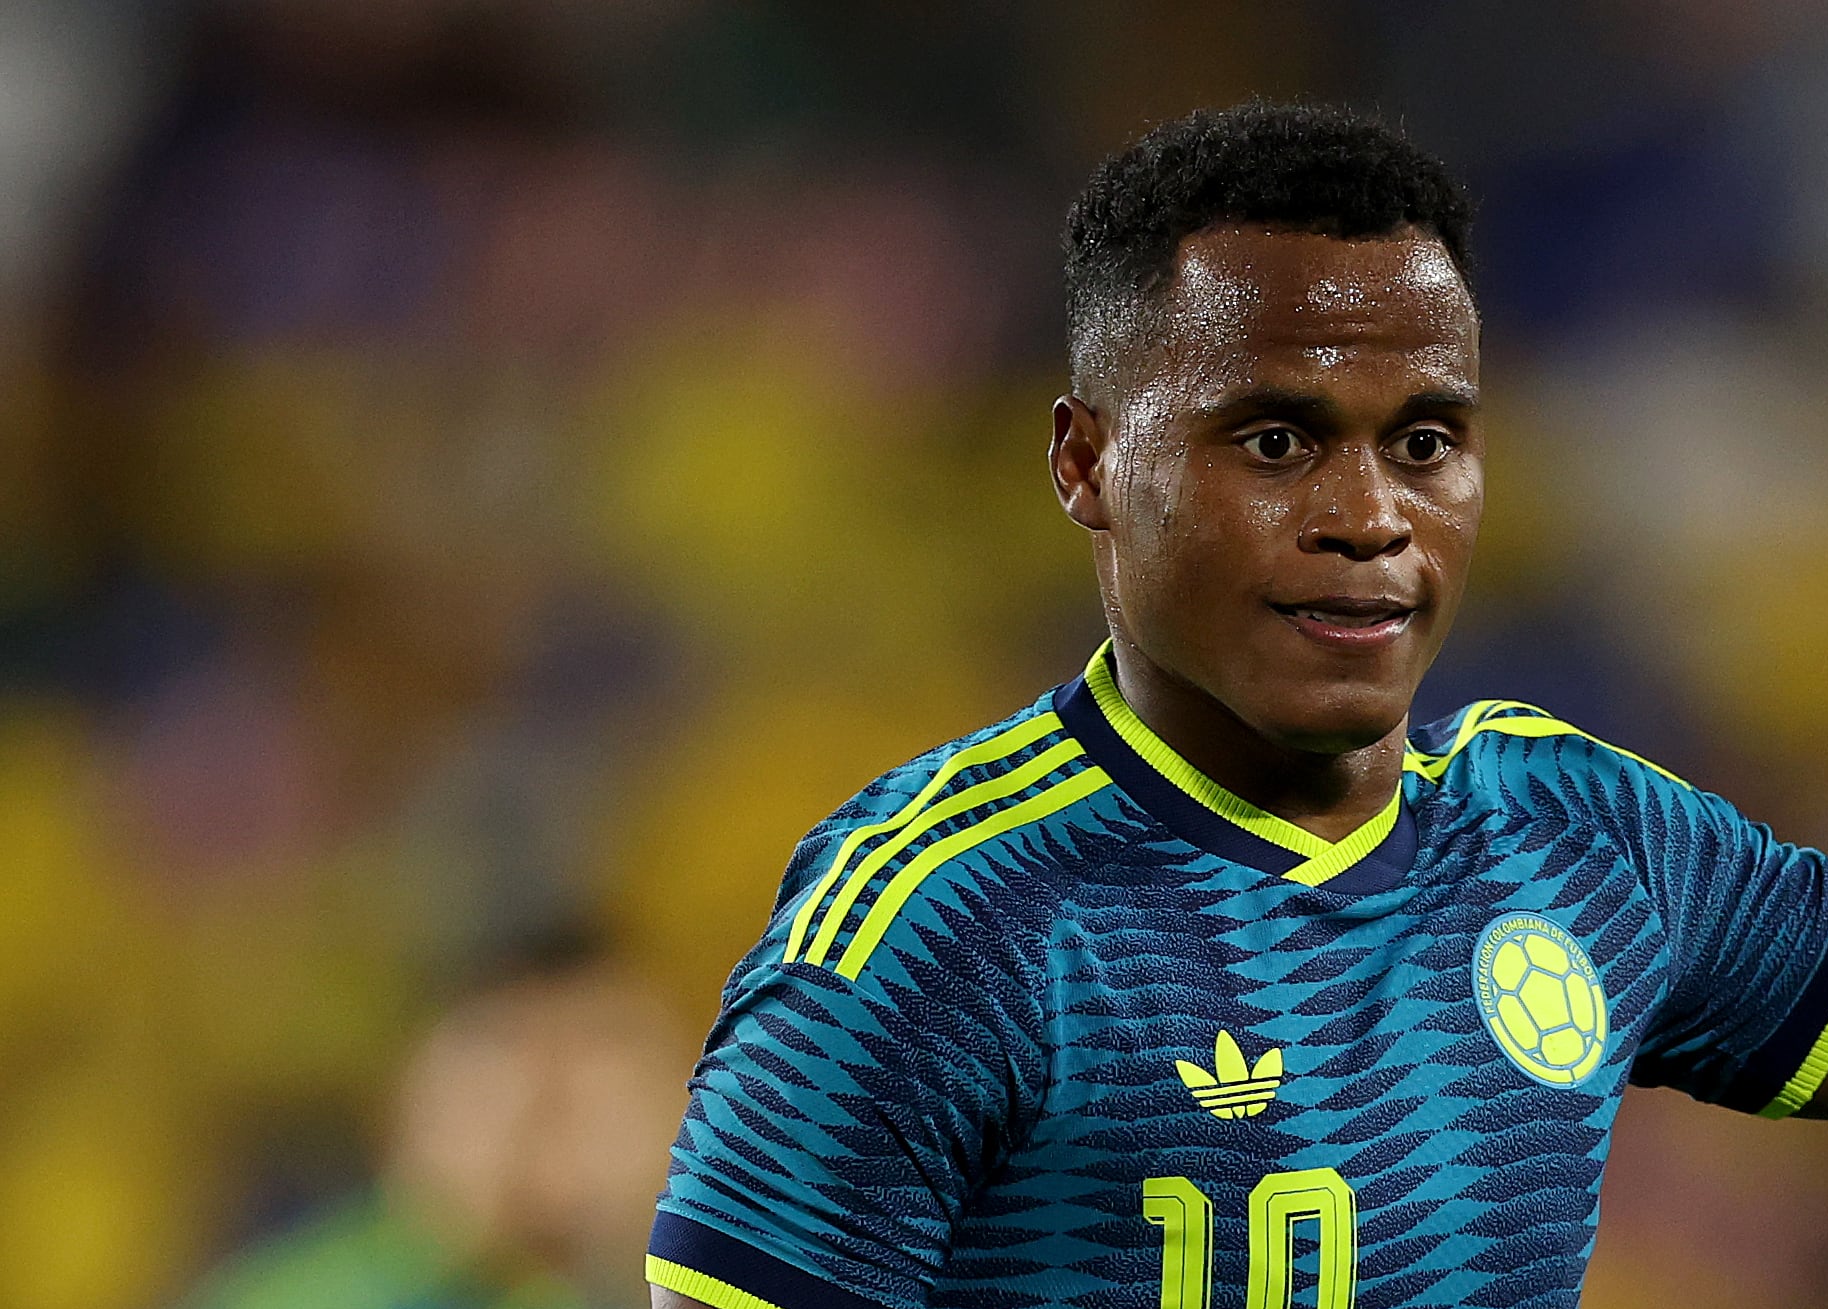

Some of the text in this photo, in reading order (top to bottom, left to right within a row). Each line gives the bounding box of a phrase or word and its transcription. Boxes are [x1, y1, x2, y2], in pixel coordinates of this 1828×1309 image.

[1477, 918, 1596, 1014] FEDERACION COLOMBIANA DE FUTBOL
